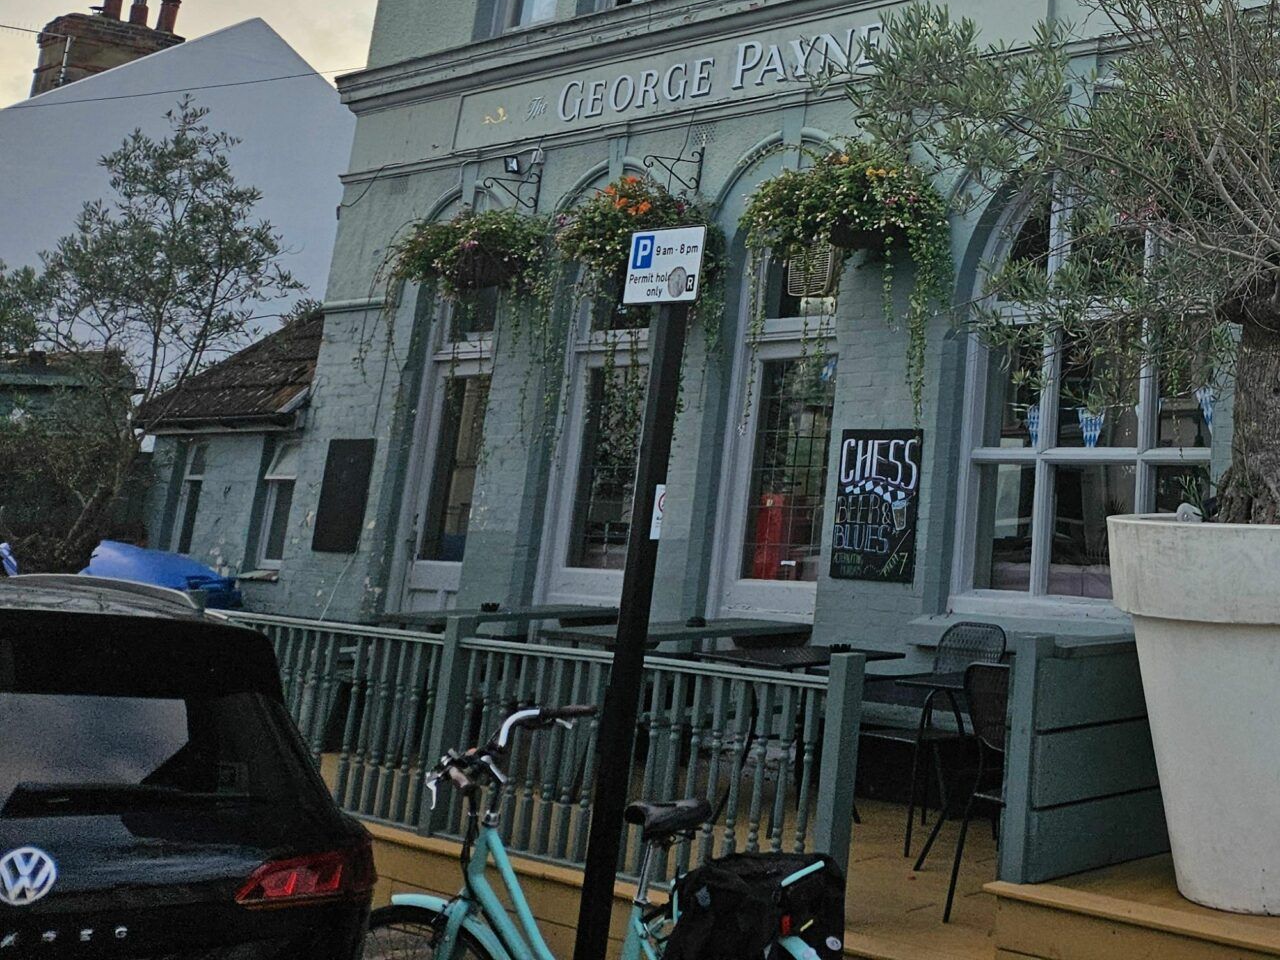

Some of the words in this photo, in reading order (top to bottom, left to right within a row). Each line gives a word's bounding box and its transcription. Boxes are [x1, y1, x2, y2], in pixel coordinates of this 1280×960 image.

[525, 96, 548, 122] The
[558, 56, 715, 123] GEORGE
[731, 21, 885, 92] PAYNE
[637, 239, 652, 266] P
[629, 274, 654, 285] Permit
[646, 286, 662, 298] only
[841, 439, 918, 490] CHESS
[835, 494, 882, 525] BEER
[882, 502, 892, 525] &
